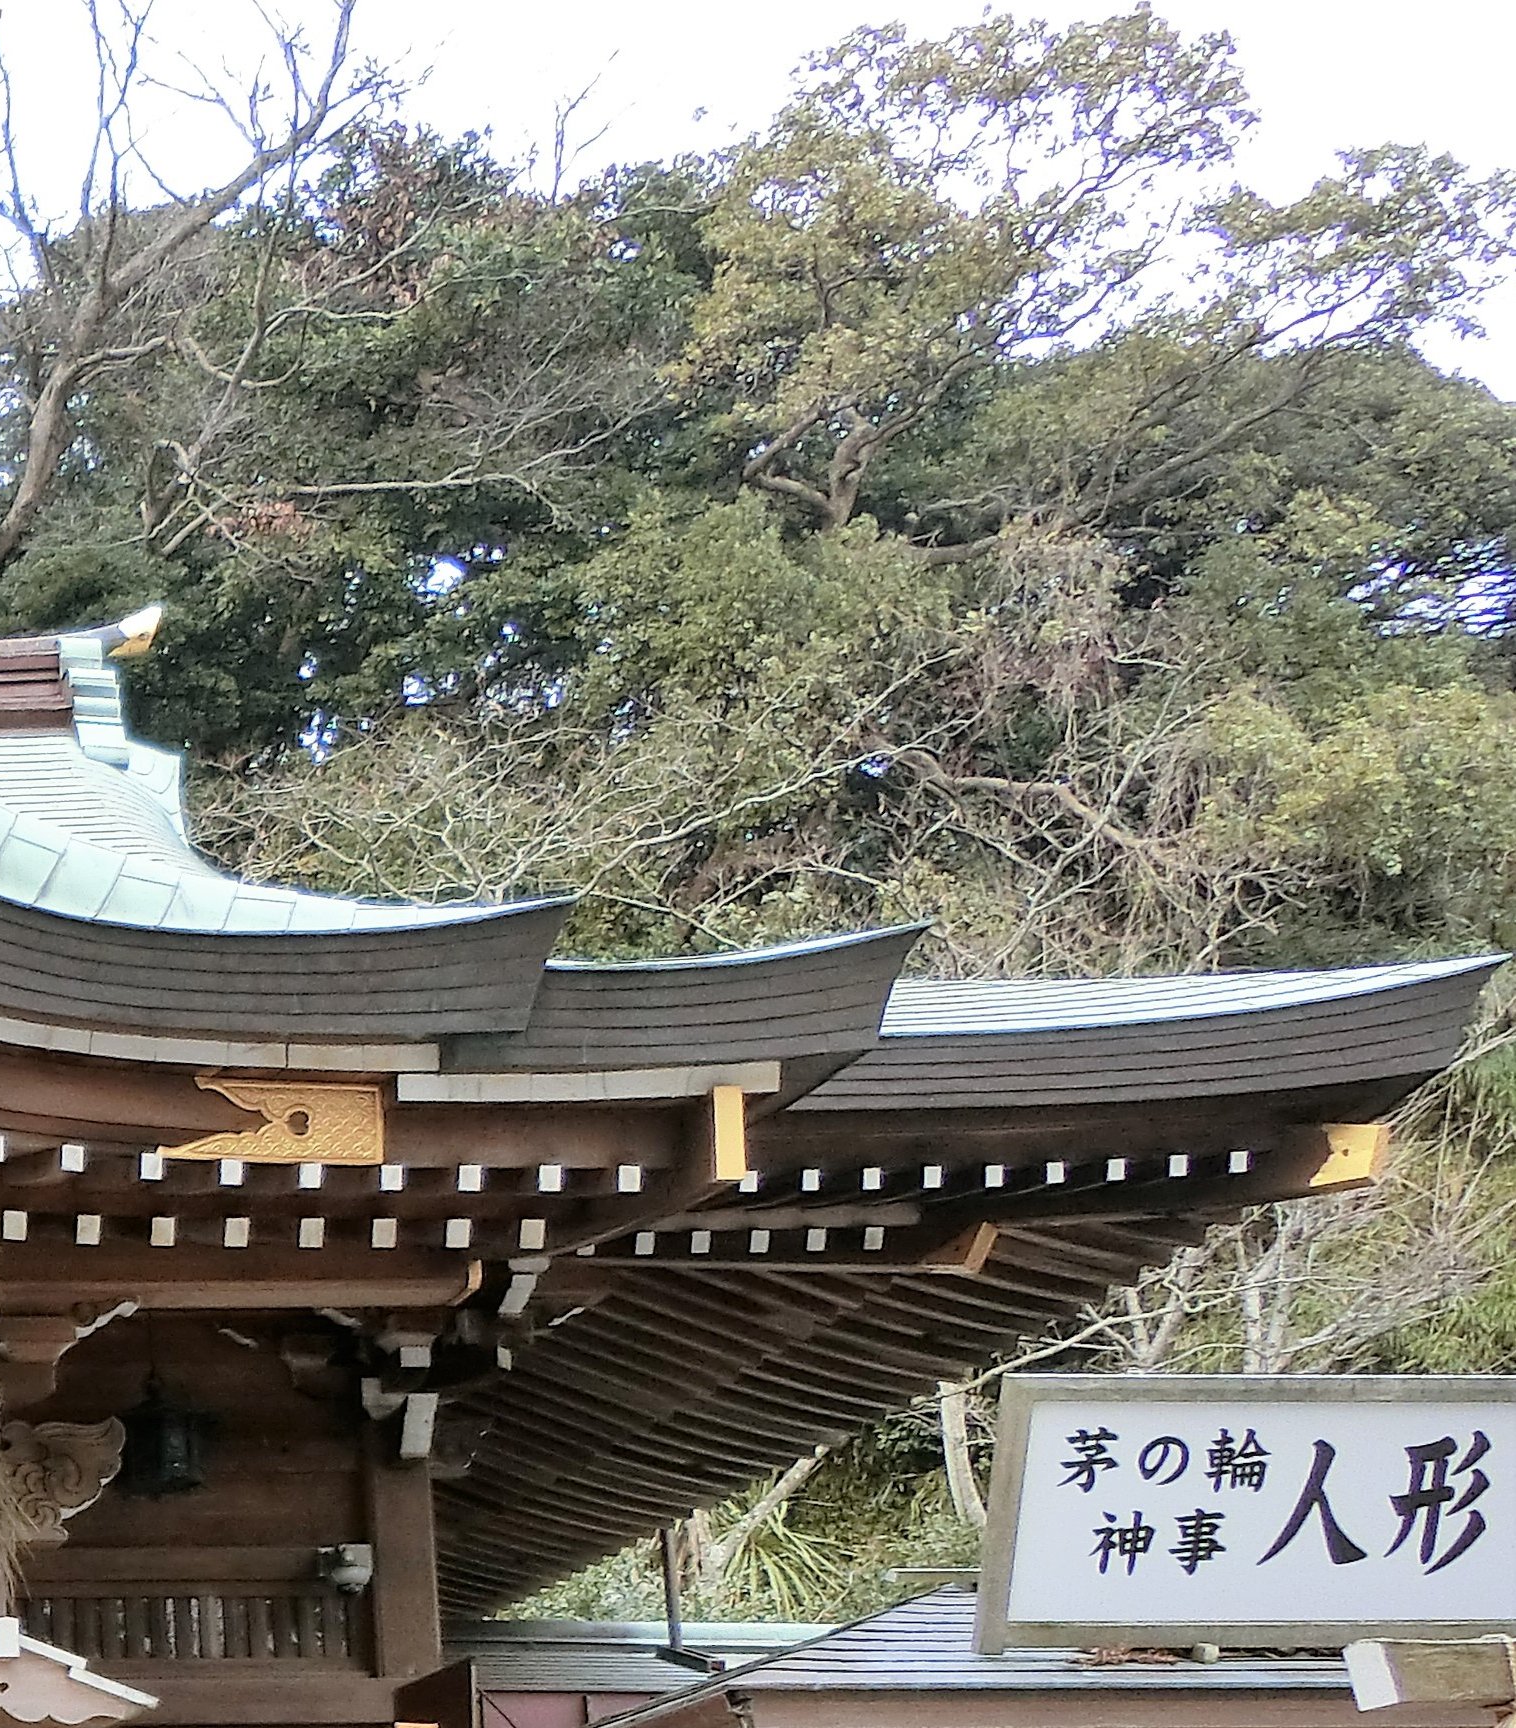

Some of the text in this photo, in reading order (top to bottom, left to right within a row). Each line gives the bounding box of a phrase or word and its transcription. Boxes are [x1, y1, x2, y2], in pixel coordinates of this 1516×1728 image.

[1056, 1426, 1272, 1493] 茅の輪
[1256, 1430, 1491, 1577] 人形
[1089, 1508, 1227, 1575] 神事
